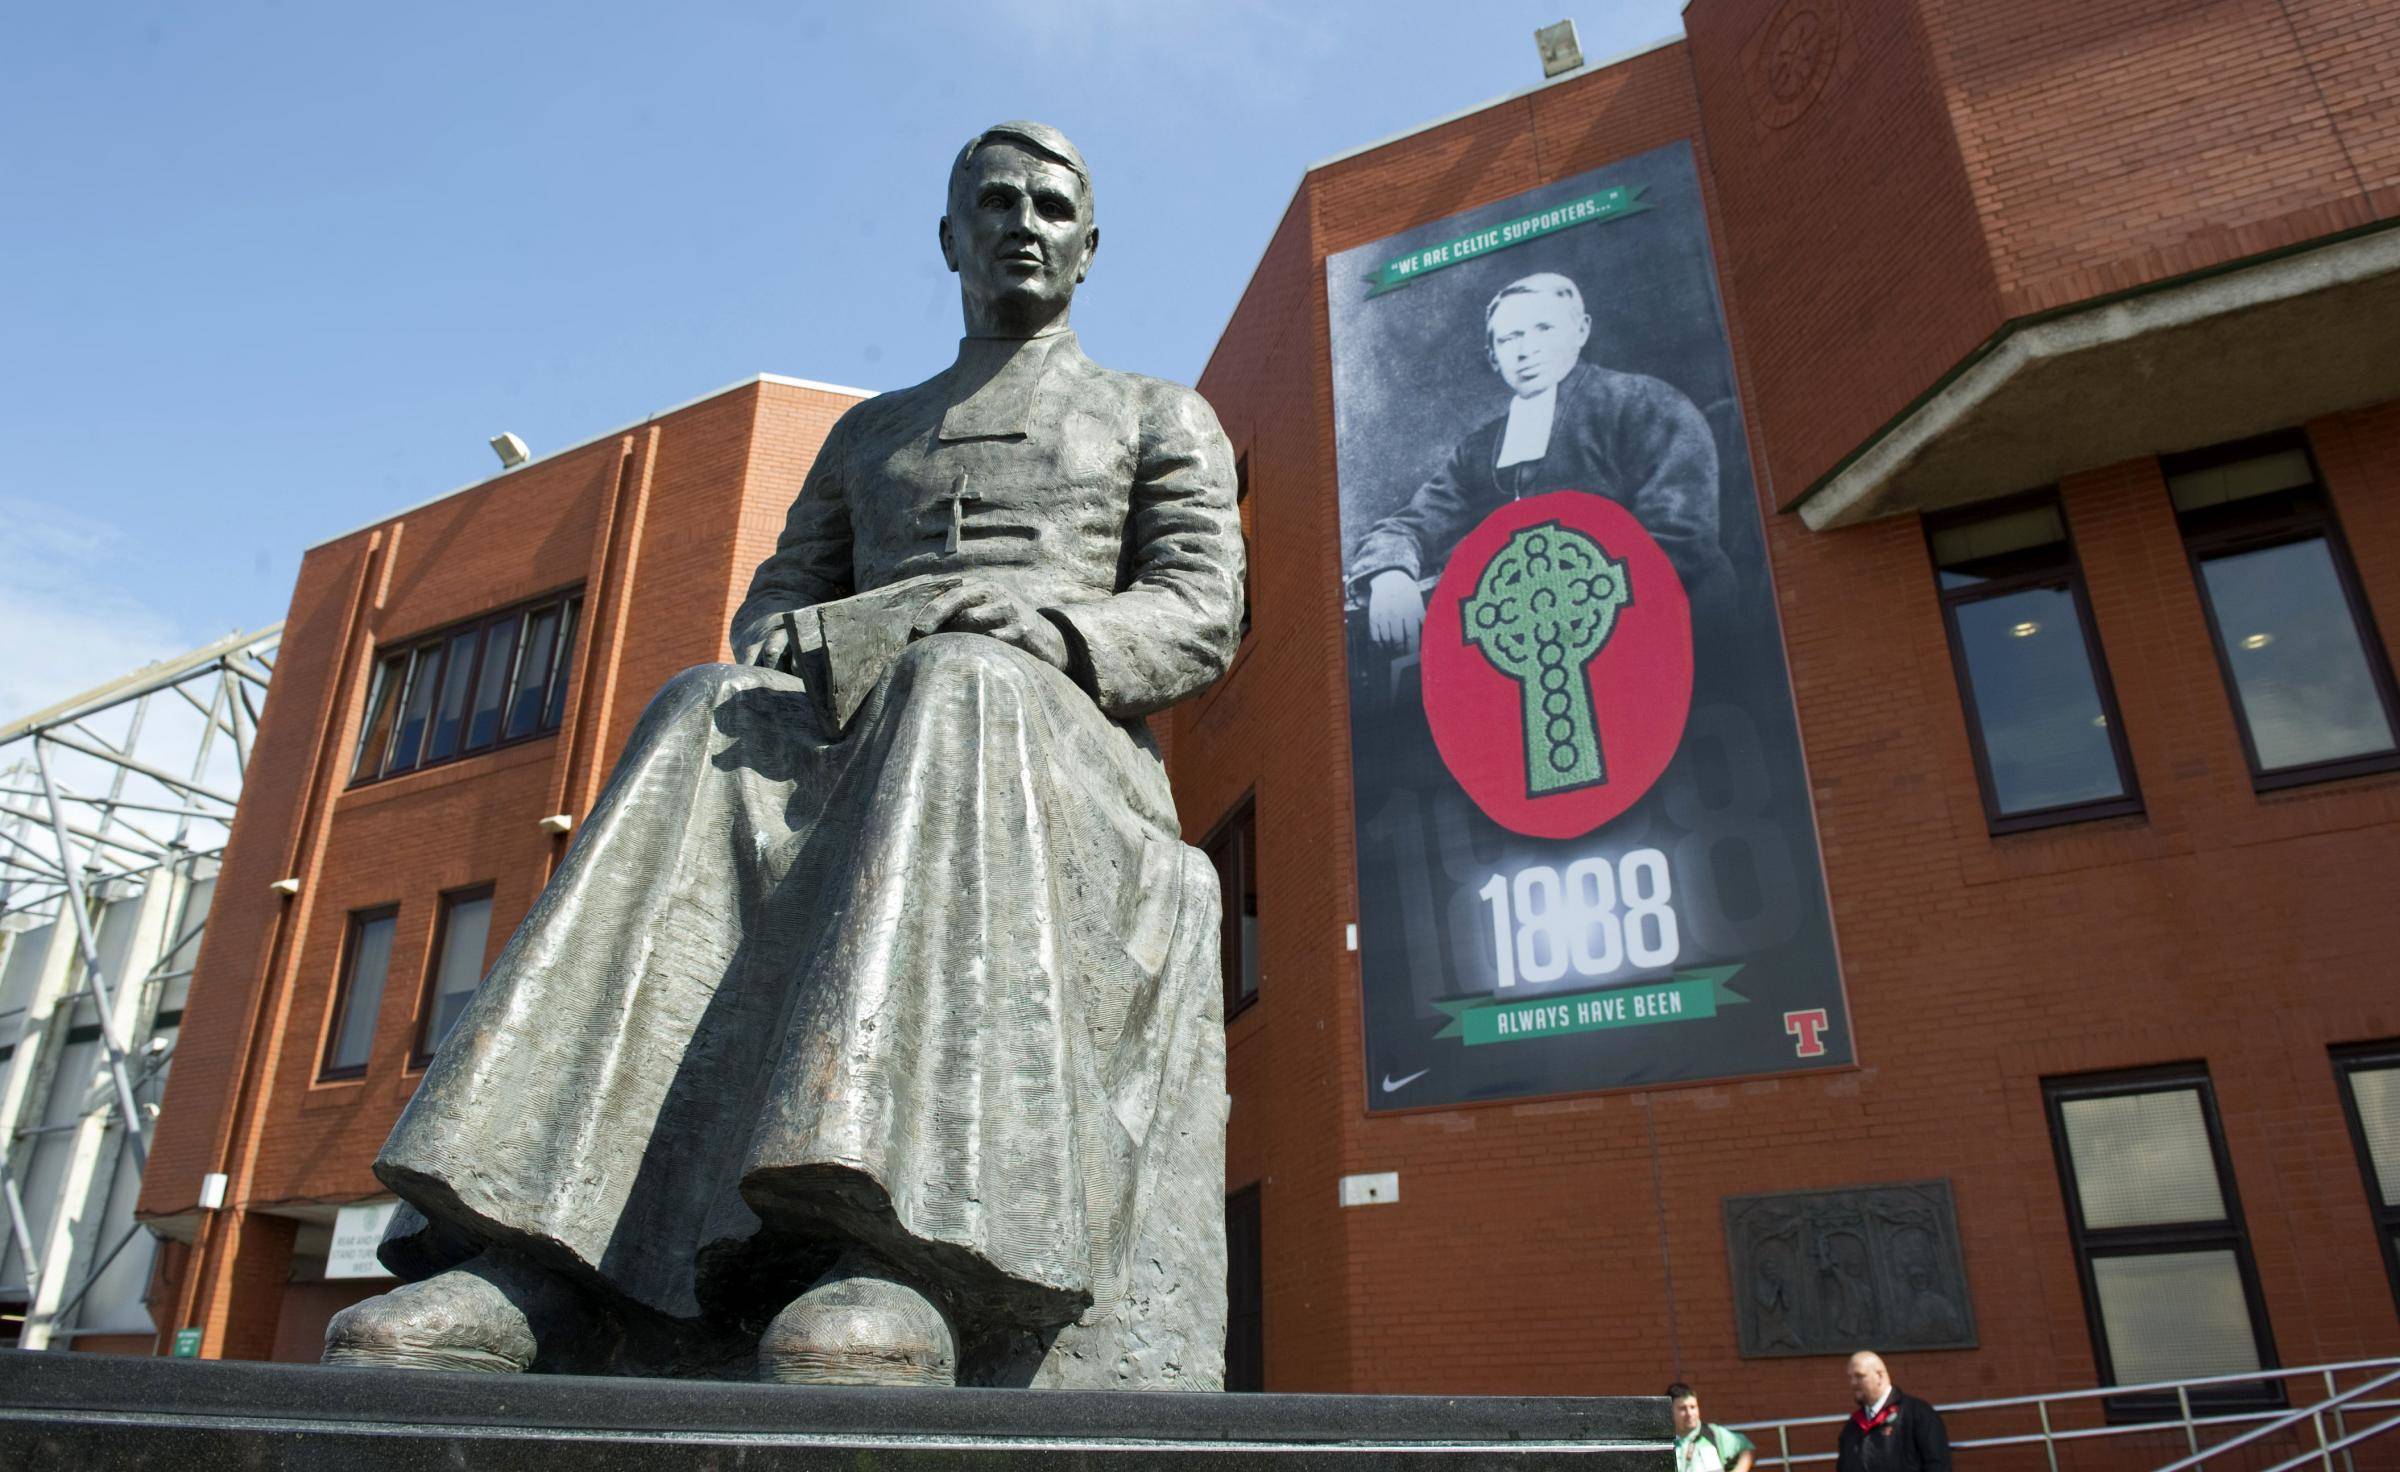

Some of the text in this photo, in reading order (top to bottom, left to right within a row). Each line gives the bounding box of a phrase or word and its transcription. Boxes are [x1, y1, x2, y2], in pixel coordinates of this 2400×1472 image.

[1423, 246, 1449, 267] ARE
[1453, 230, 1499, 257] CELTIC
[1479, 848, 1681, 988] 1888
[1497, 991, 1682, 1034] ALWAYS HAVE BEEN
[1783, 1008, 1829, 1058] T
